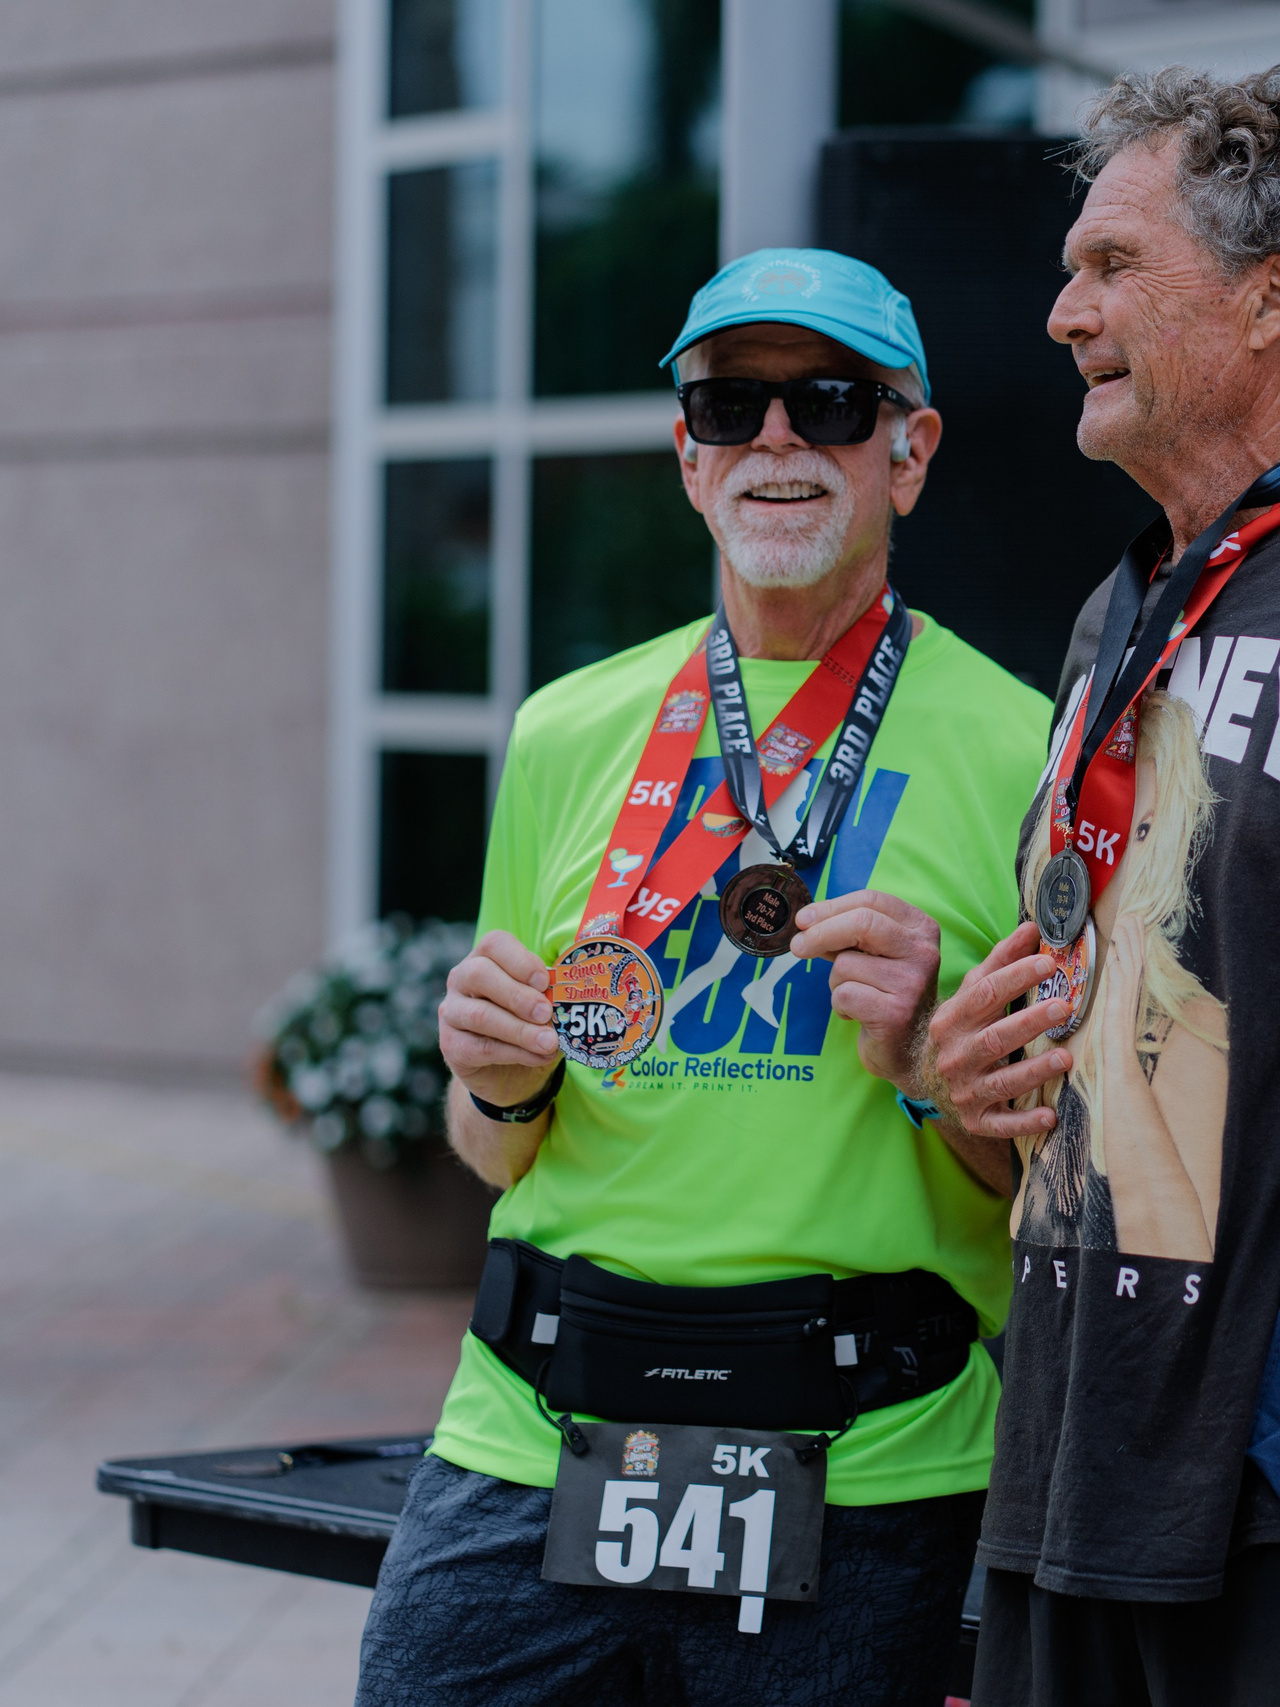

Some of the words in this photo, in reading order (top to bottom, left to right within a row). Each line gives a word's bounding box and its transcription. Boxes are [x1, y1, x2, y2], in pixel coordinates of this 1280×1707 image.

[710, 629, 735, 676] 3RD
[714, 681, 752, 754] PLACE
[830, 724, 870, 786] 3RD
[854, 634, 900, 725] PLACE
[628, 780, 677, 807] 5K
[1077, 820, 1120, 866] 5K
[627, 887, 681, 923] 5K
[756, 902, 776, 919] 70-74
[762, 892, 780, 908] Male
[744, 910, 759, 923] 3rd
[756, 916, 775, 932] Place
[563, 962, 608, 981] Cinco
[565, 983, 611, 1001] Drinko
[570, 1004, 607, 1037] 5K
[630, 1056, 679, 1077] Color
[684, 1056, 814, 1082] Reflections
[693, 1082, 733, 1092] PRINT
[740, 1084, 758, 1093] IT.
[661, 1368, 728, 1380] FITLETIC
[710, 1444, 773, 1479] 5K
[595, 1479, 776, 1592] 541
